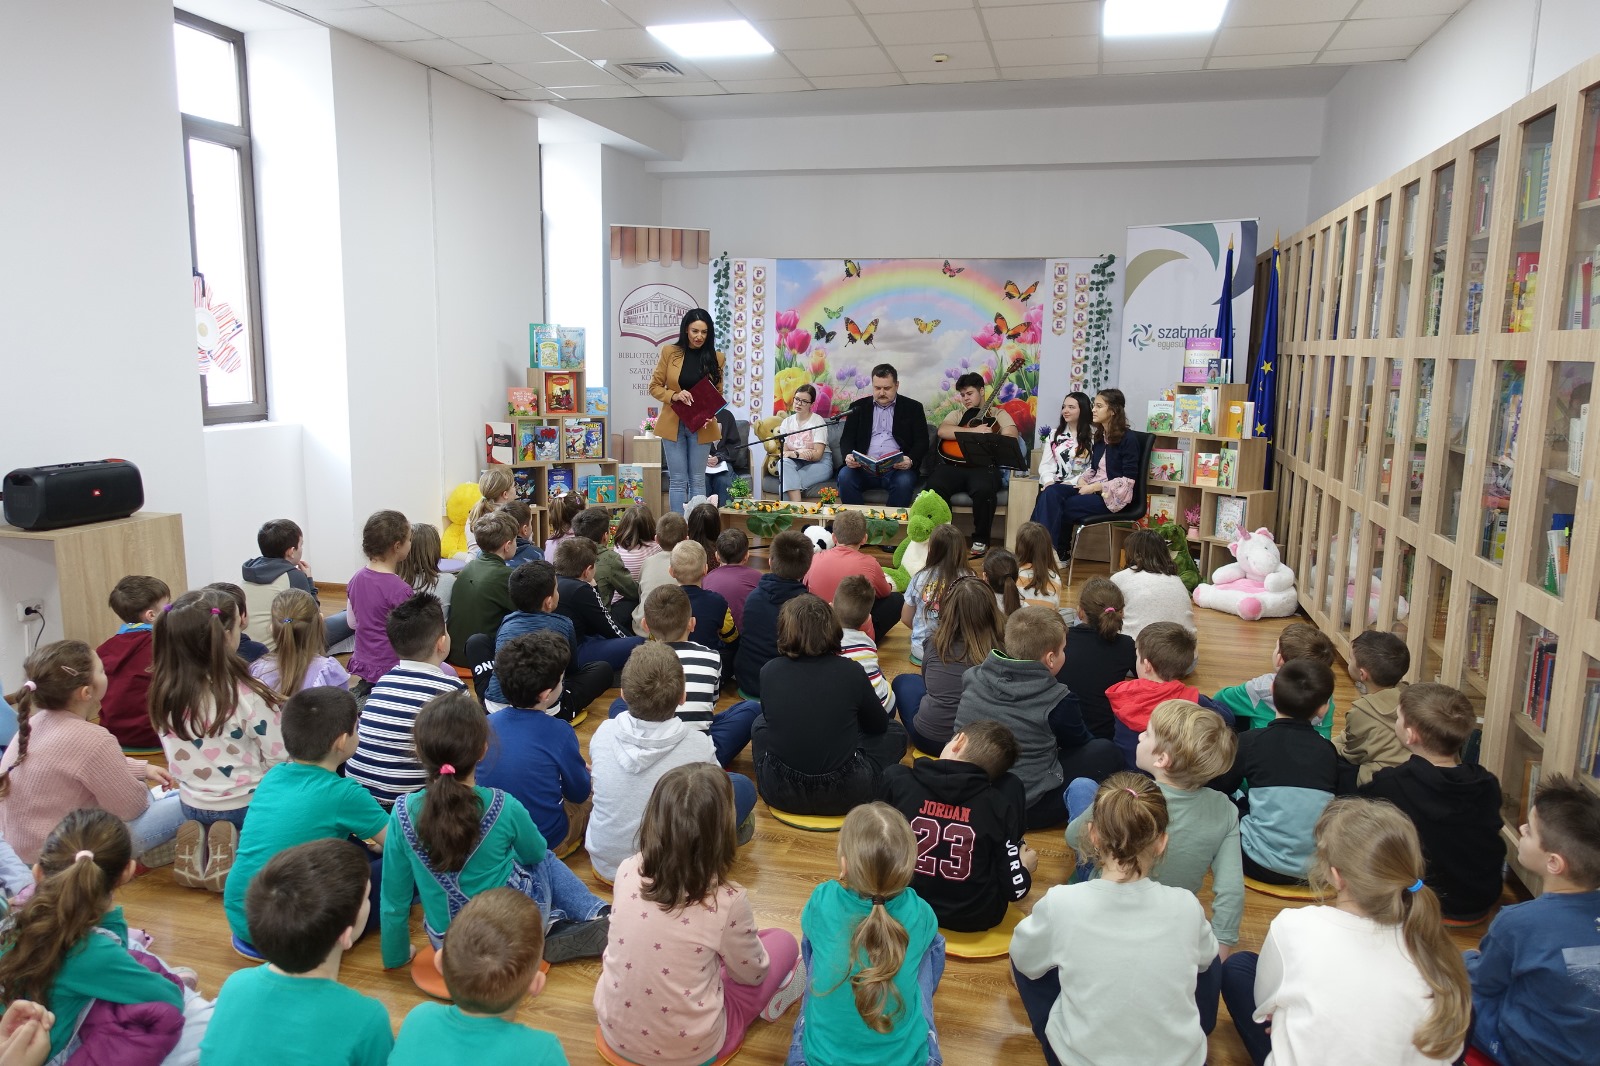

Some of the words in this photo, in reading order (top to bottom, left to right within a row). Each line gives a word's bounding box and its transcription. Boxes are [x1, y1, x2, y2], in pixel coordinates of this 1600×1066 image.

[1056, 267, 1066, 329] MESE
[735, 264, 744, 401] MARATONUL
[1073, 277, 1087, 389] MARATON
[629, 367, 654, 375] SZATM
[919, 800, 971, 822] JORDAN
[910, 816, 976, 881] 23
